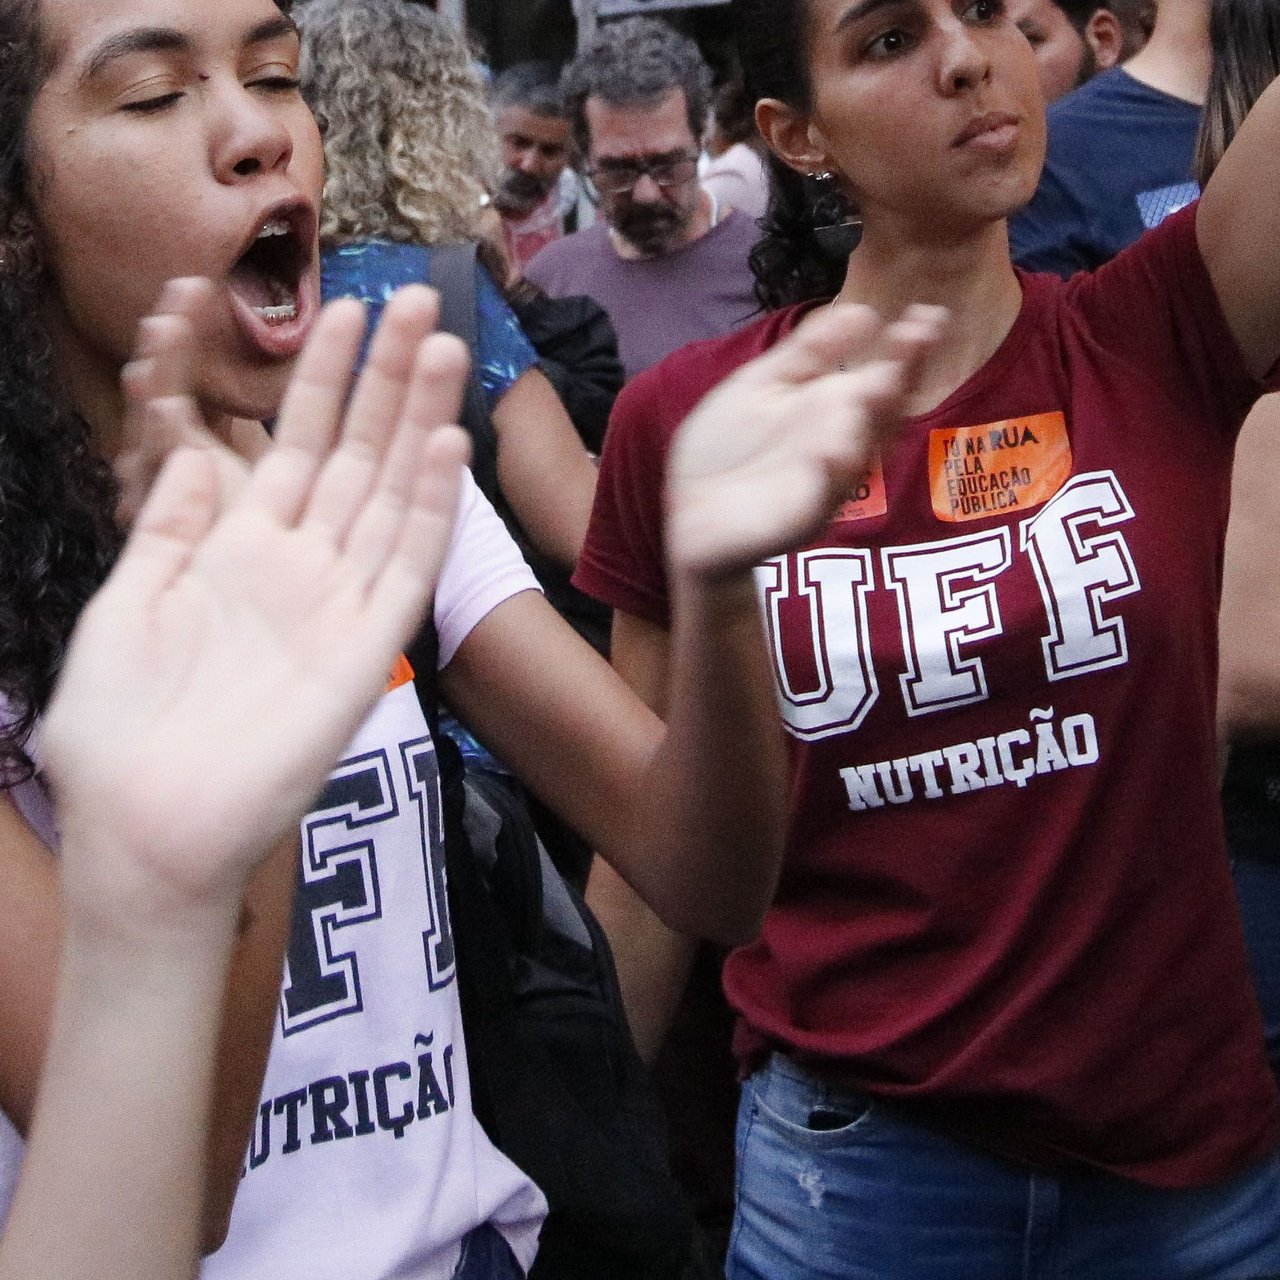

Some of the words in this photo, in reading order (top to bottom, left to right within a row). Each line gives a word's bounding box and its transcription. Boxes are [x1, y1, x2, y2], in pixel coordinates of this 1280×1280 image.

[944, 458, 985, 478] PELA
[965, 434, 986, 457] NA
[988, 425, 1040, 452] RUA
[752, 469, 1142, 743] UFF
[839, 705, 1100, 812] NUTRIÇÃO
[241, 1029, 457, 1179] UTRIÇÃ
